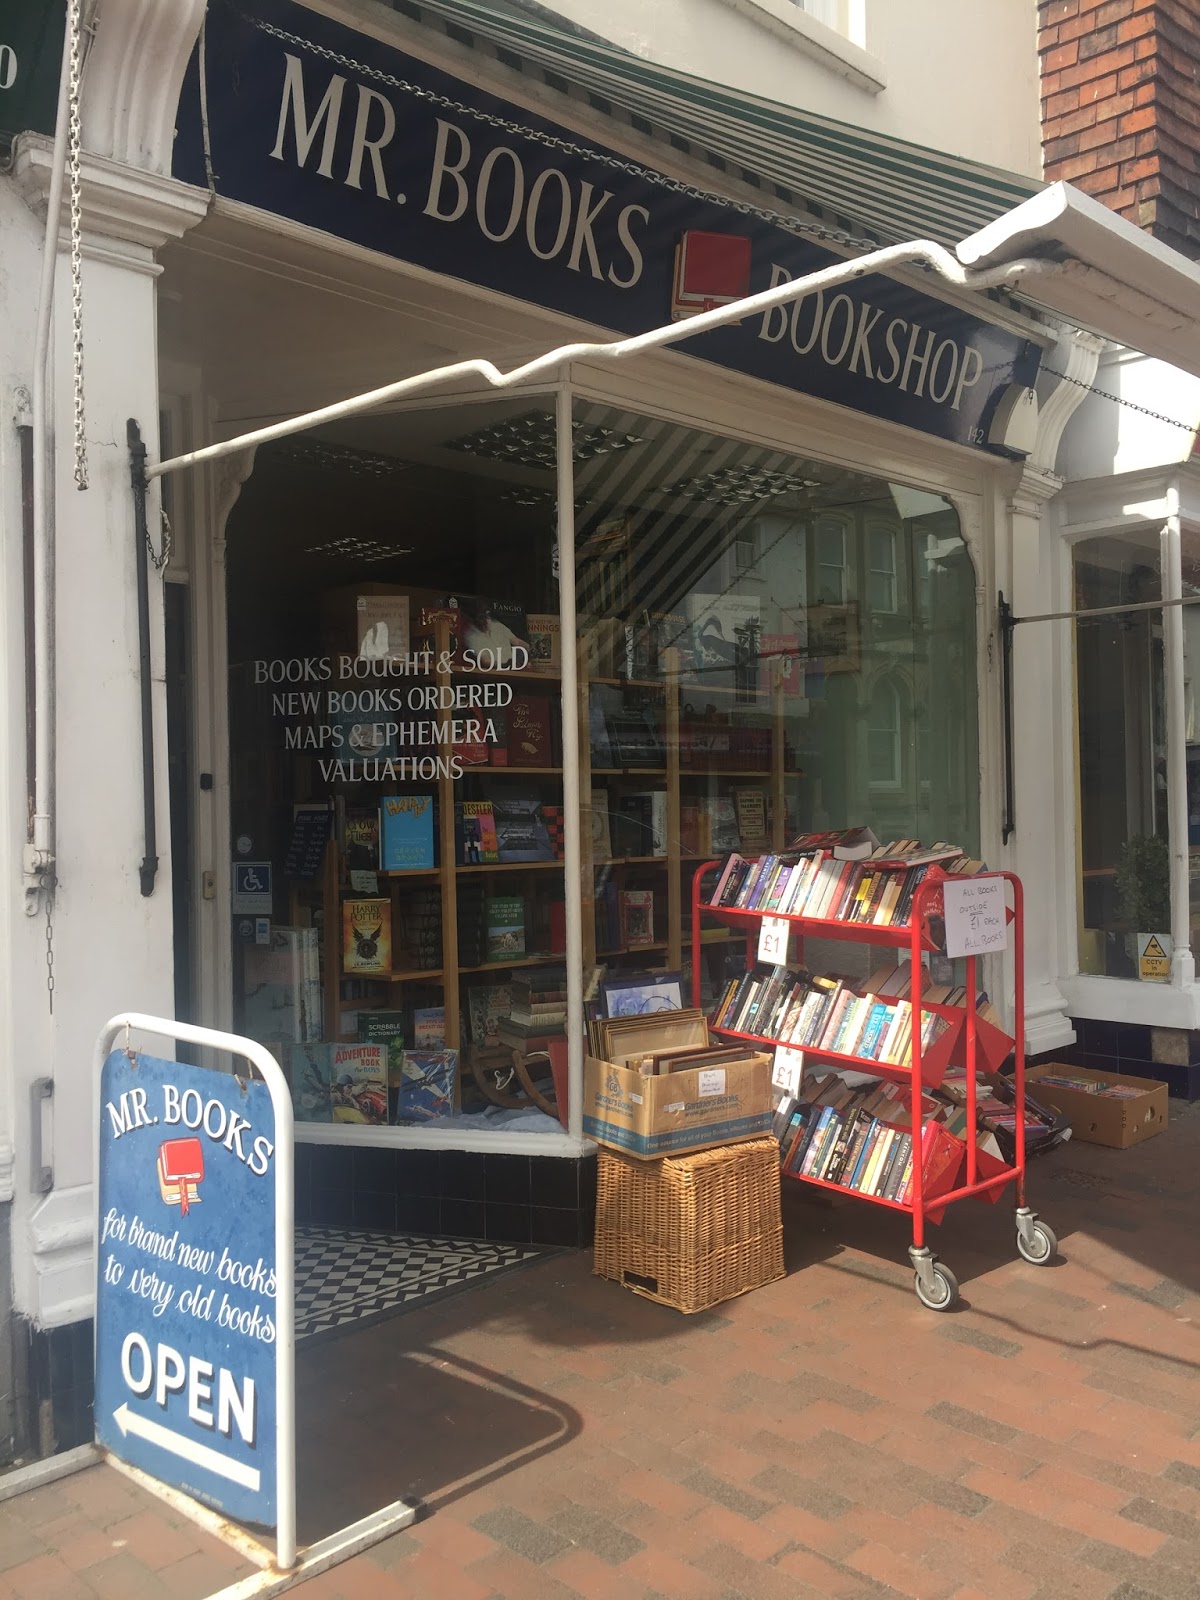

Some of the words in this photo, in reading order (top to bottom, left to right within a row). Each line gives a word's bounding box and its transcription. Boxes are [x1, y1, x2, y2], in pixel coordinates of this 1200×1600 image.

[268, 52, 407, 204] MR.
[422, 116, 651, 290] BOOKS
[757, 262, 984, 412] BOOKSHOP
[967, 424, 986, 446] 142
[493, 601, 522, 613] FANGIO
[253, 656, 332, 684] BOOKS
[339, 650, 435, 680] BOUGHT
[436, 653, 455, 675] &
[461, 646, 529, 673] SOLD
[271, 691, 321, 717] NEW
[327, 687, 403, 714] BOOKS
[407, 682, 513, 711] ORDERED
[284, 724, 345, 750] MAPS
[349, 724, 367, 747] &
[372, 718, 499, 747] EPHEMERA
[318, 755, 464, 783] VALUATIONS
[963, 888, 975, 897] ALL
[977, 885, 997, 894] BOOKS
[350, 912, 384, 922] POTTER
[352, 905, 382, 914] HARRY
[959, 901, 988, 914] OUTSIDE
[763, 934, 780, 954] £1
[964, 937, 978, 950] ALL
[980, 930, 1004, 946] BOOKS
[335, 1046, 380, 1064] ADVENTURE
[360, 1058, 380, 1066] BOOK
[776, 1066, 792, 1086] £1
[716, 1094, 740, 1106] Books
[105, 1087, 159, 1138] MR.
[162, 1084, 274, 1176] BOOKS
[101, 1208, 126, 1244] for
[128, 1215, 178, 1261] brand
[178, 1242, 215, 1275] new
[216, 1248, 277, 1298] books
[104, 1254, 125, 1286] to
[128, 1266, 175, 1317] very
[175, 1284, 215, 1322] old
[215, 1294, 276, 1344] books
[121, 1332, 256, 1444] OPEN
